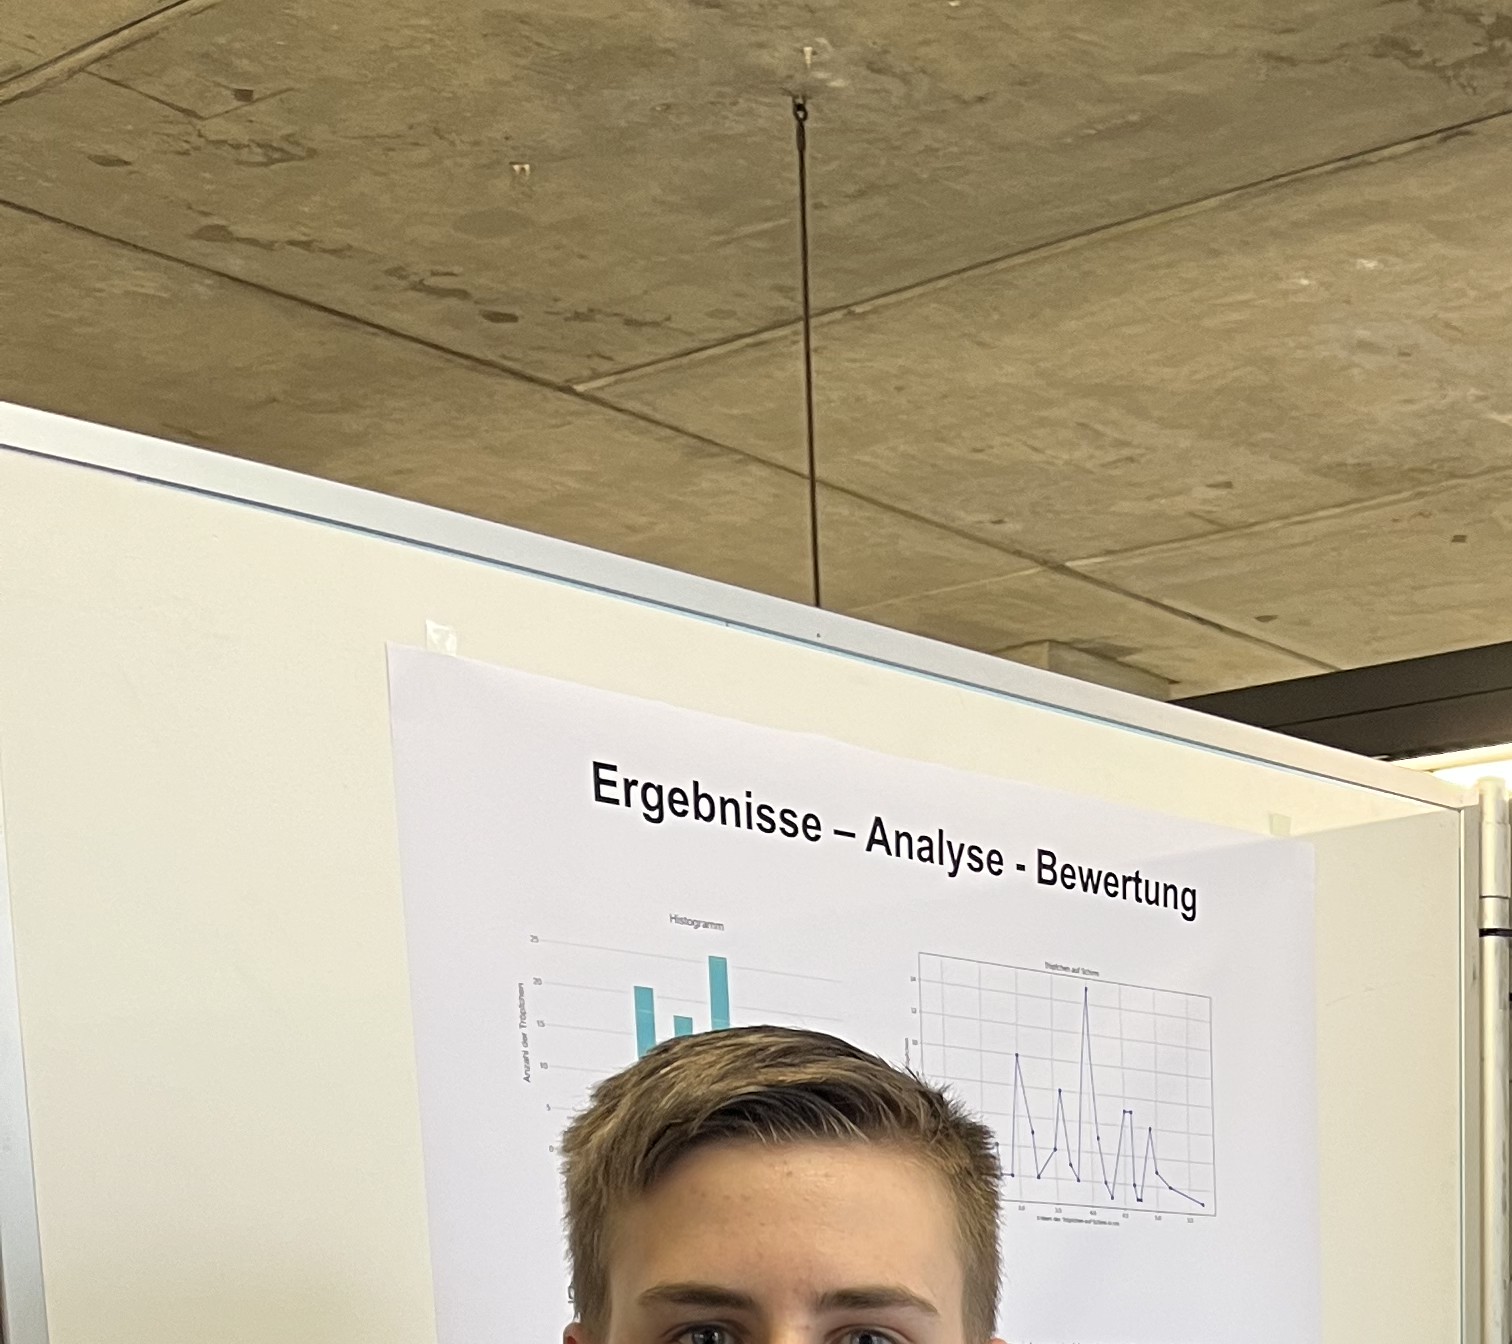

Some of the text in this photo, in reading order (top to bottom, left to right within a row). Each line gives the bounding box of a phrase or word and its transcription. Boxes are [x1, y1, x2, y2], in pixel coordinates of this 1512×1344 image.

[592, 760, 823, 843] Ergebnisse
[866, 816, 1005, 878] Analyse
[1036, 849, 1199, 922] Bewertung
[669, 913, 725, 932] Histogramm
